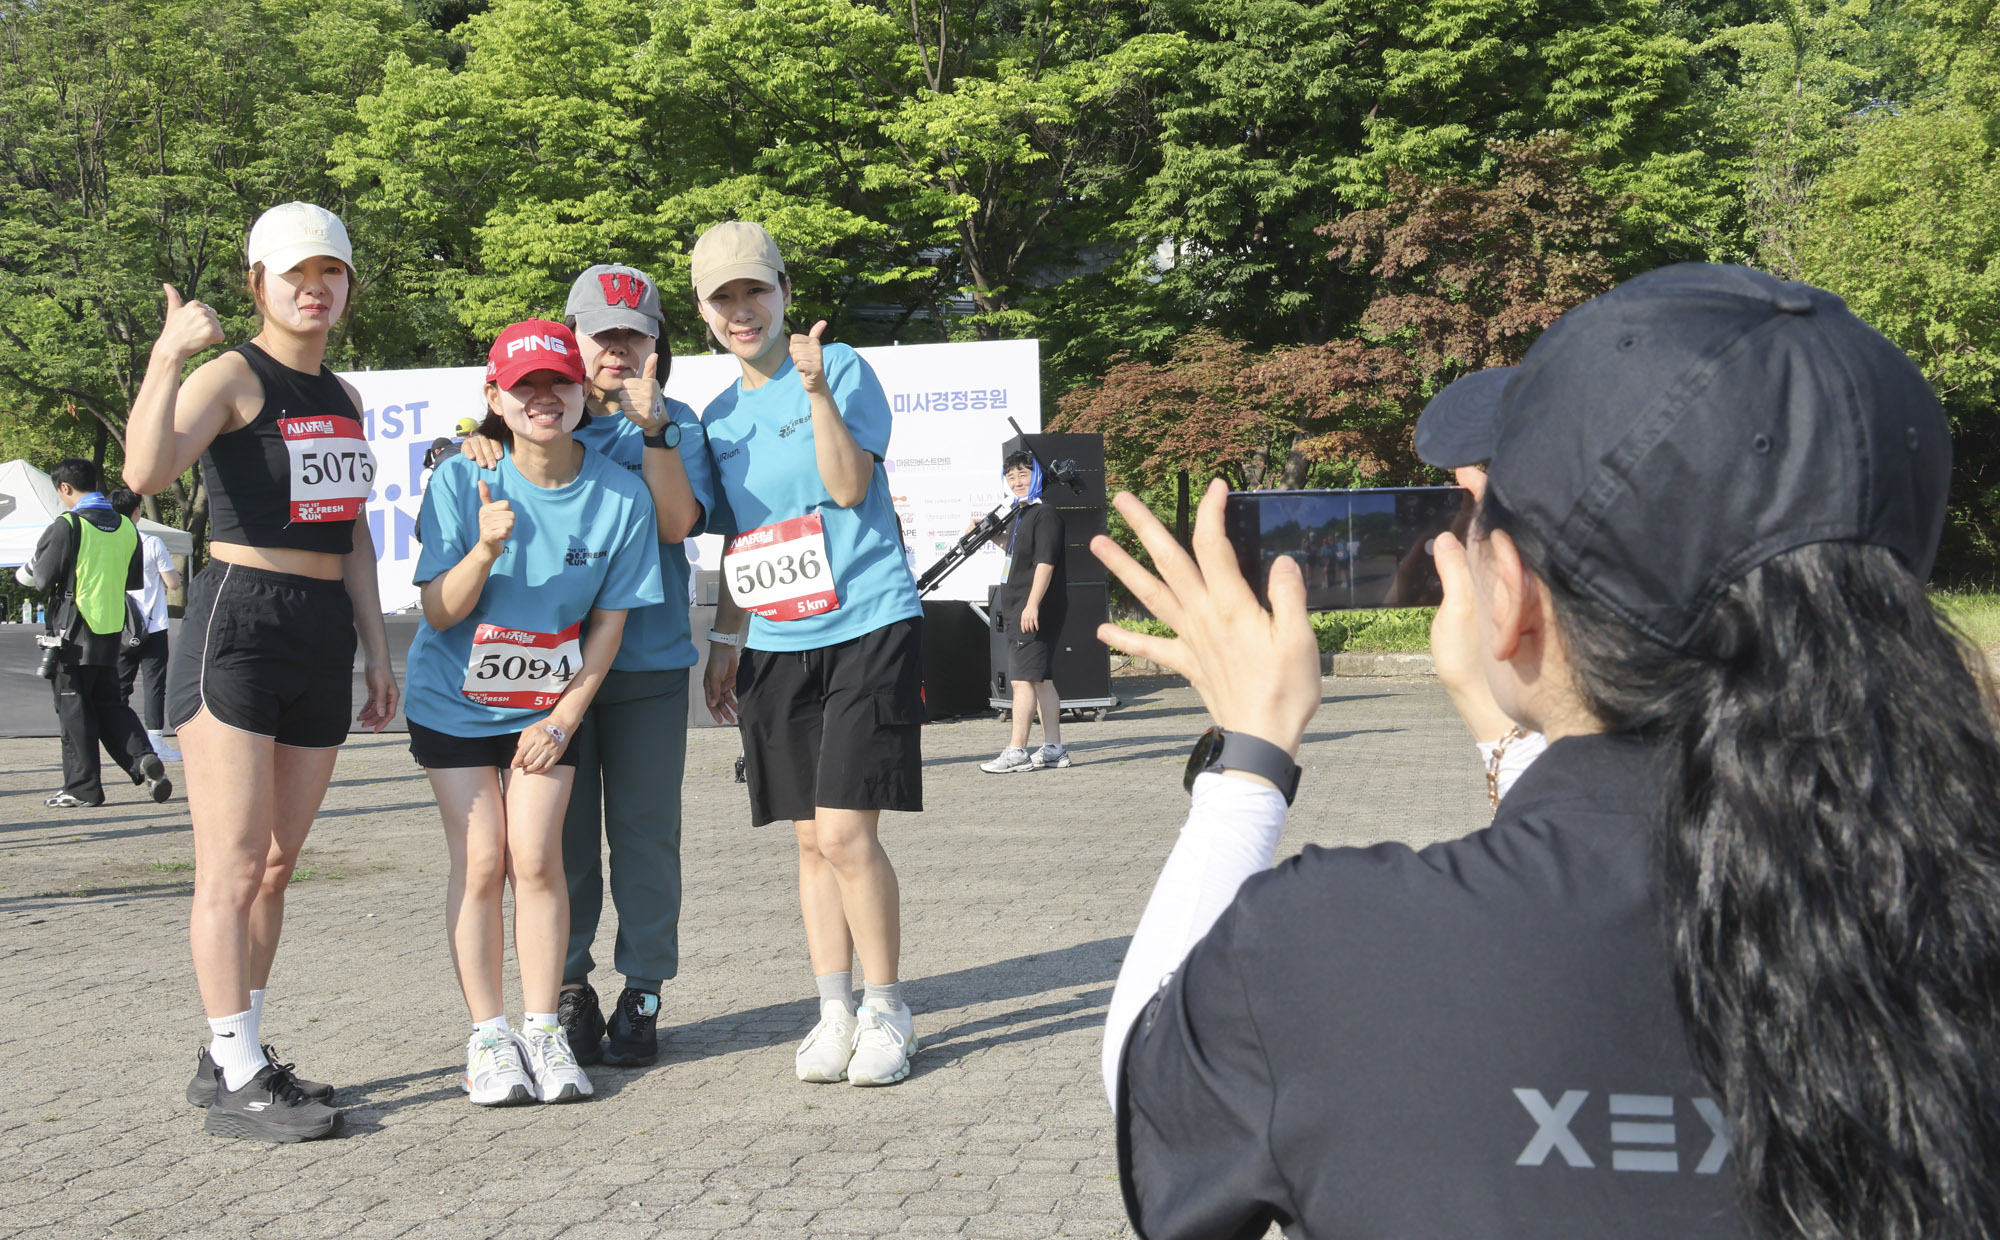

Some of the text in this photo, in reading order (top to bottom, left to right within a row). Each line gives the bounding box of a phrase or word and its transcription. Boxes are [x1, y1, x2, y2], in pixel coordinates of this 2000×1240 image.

[598, 273, 646, 309] W
[507, 334, 568, 358] PING
[893, 389, 1007, 413] 미사경정공원
[287, 420, 335, 435] 시사저널
[363, 401, 429, 441] 1ST
[302, 451, 374, 485] 5075
[735, 549, 821, 594] 5036
[797, 599, 828, 613] 5 km
[482, 629, 537, 644] 시사저널
[476, 654, 575, 682] 5094
[533, 696, 544, 706] 5
